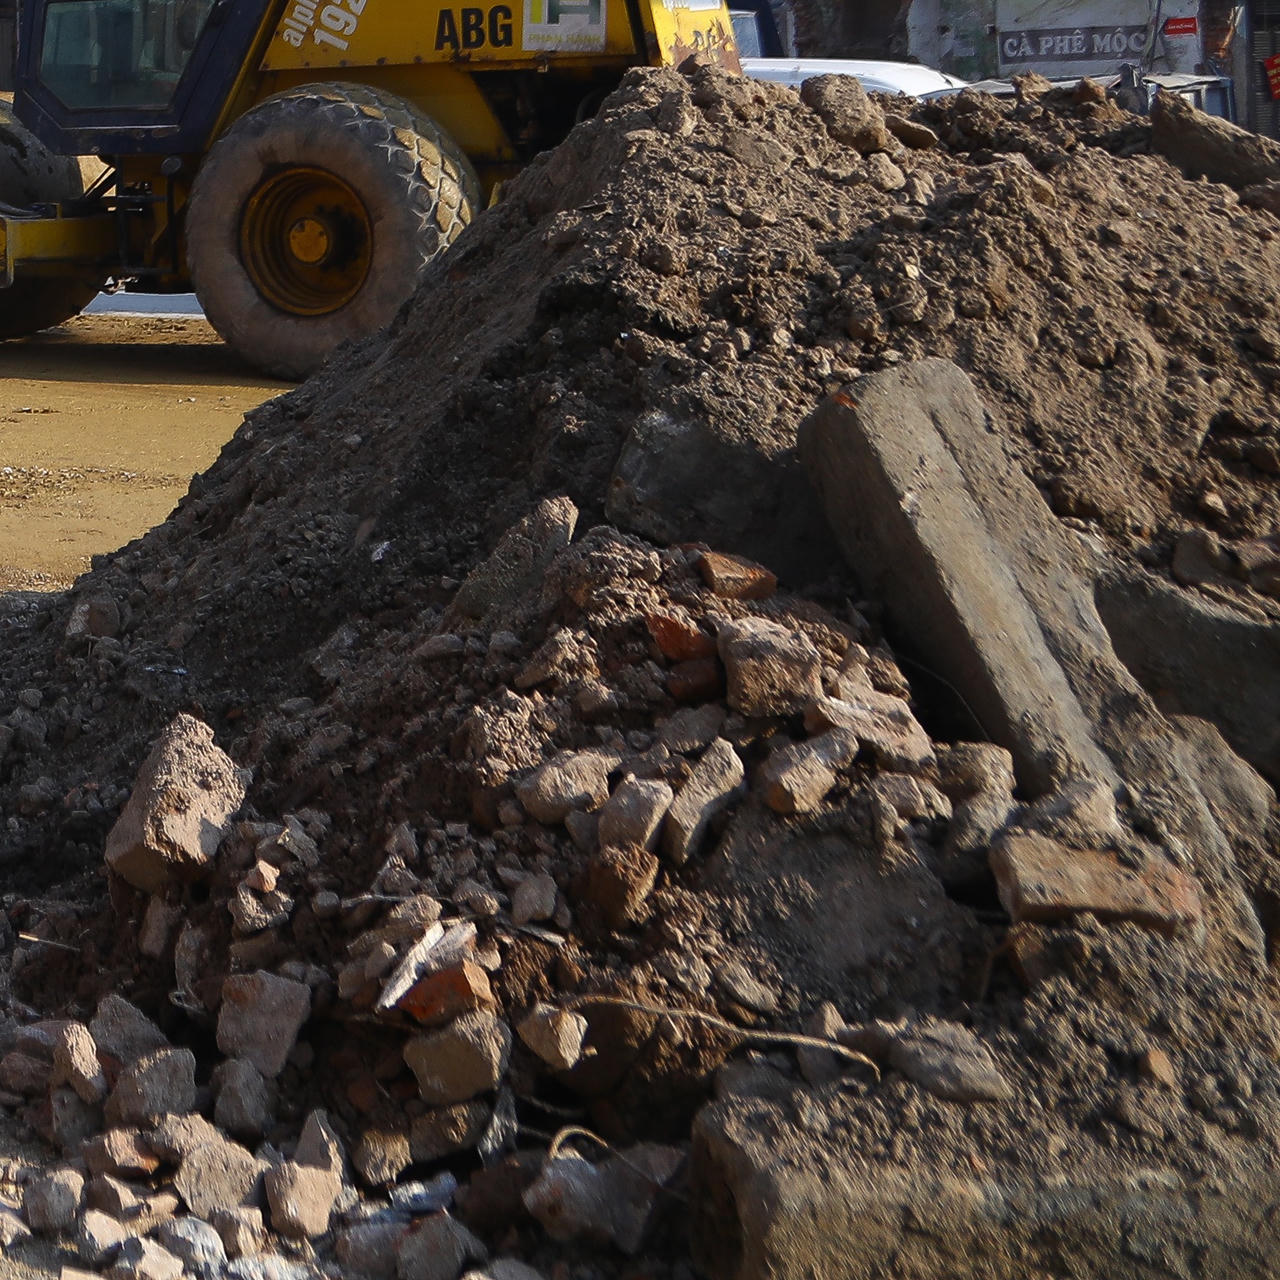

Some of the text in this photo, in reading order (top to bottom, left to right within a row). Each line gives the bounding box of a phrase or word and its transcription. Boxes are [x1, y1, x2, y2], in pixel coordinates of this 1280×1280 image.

[435, 5, 513, 52] ABG
[1039, 28, 1087, 56] PHÊ
[1092, 27, 1146, 58] MỘC
